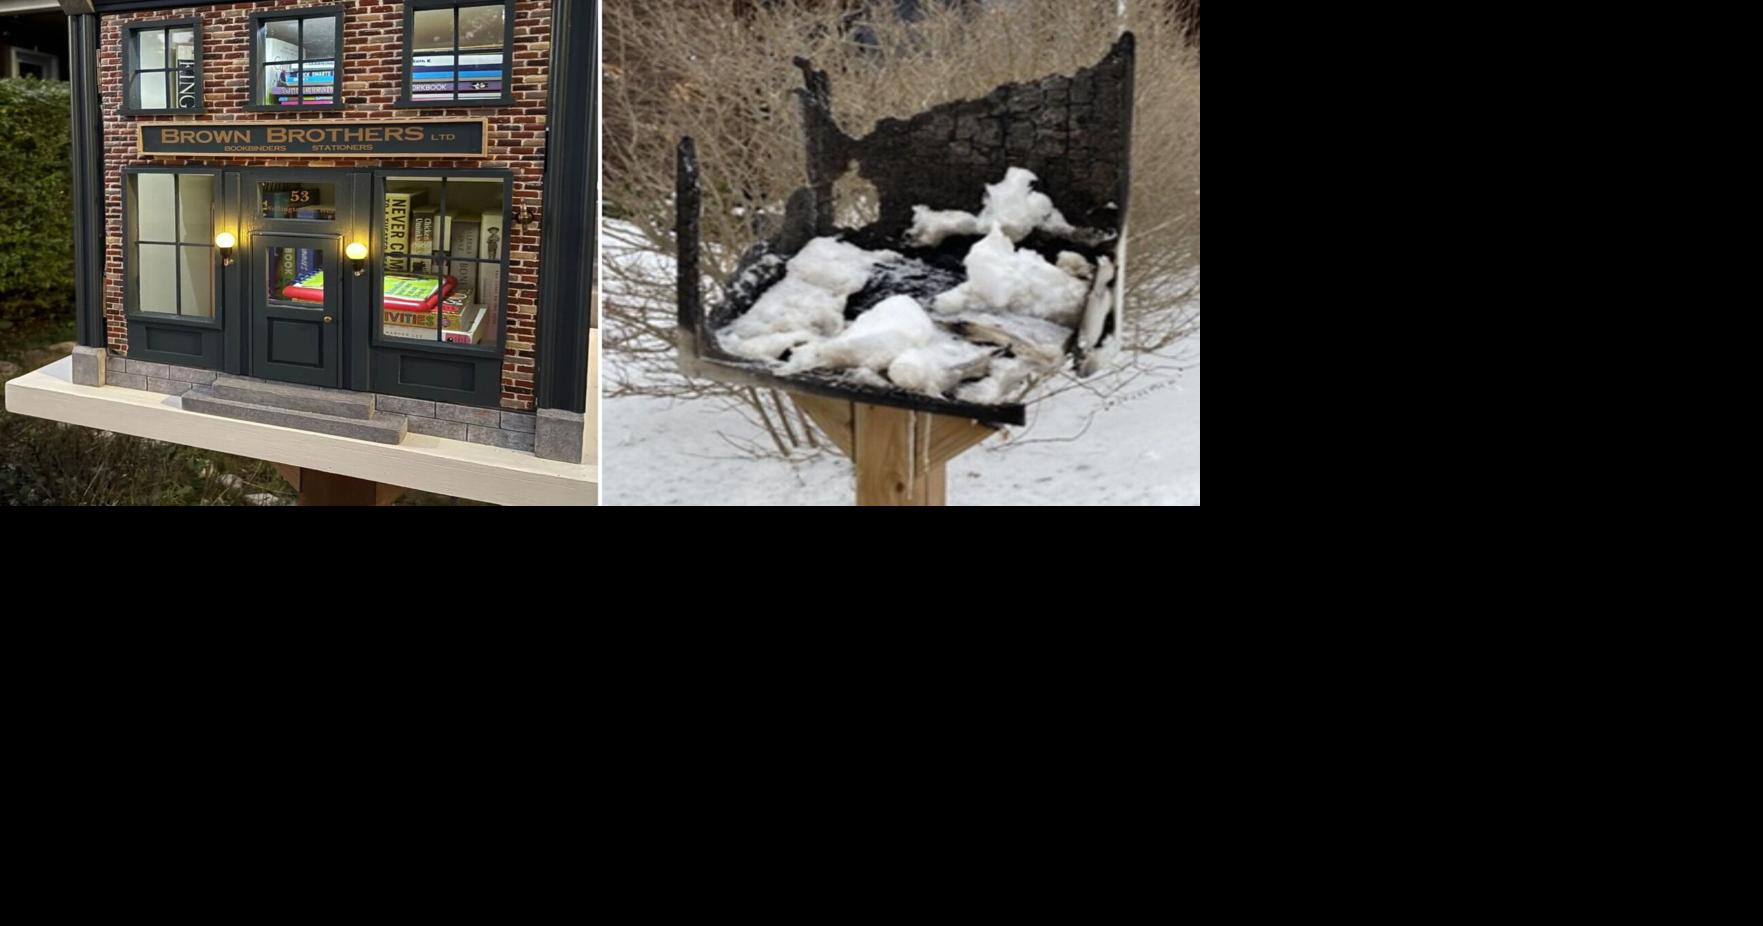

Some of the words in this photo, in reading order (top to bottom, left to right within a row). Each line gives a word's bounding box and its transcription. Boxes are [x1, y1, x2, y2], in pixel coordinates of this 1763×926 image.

[180, 61, 195, 109] KING
[161, 128, 251, 144] BROWN
[266, 126, 425, 143] BROTHERS
[431, 133, 456, 141] LTD
[290, 190, 310, 202] 53
[390, 199, 407, 239] NEVER
[283, 247, 294, 275] BOOK
